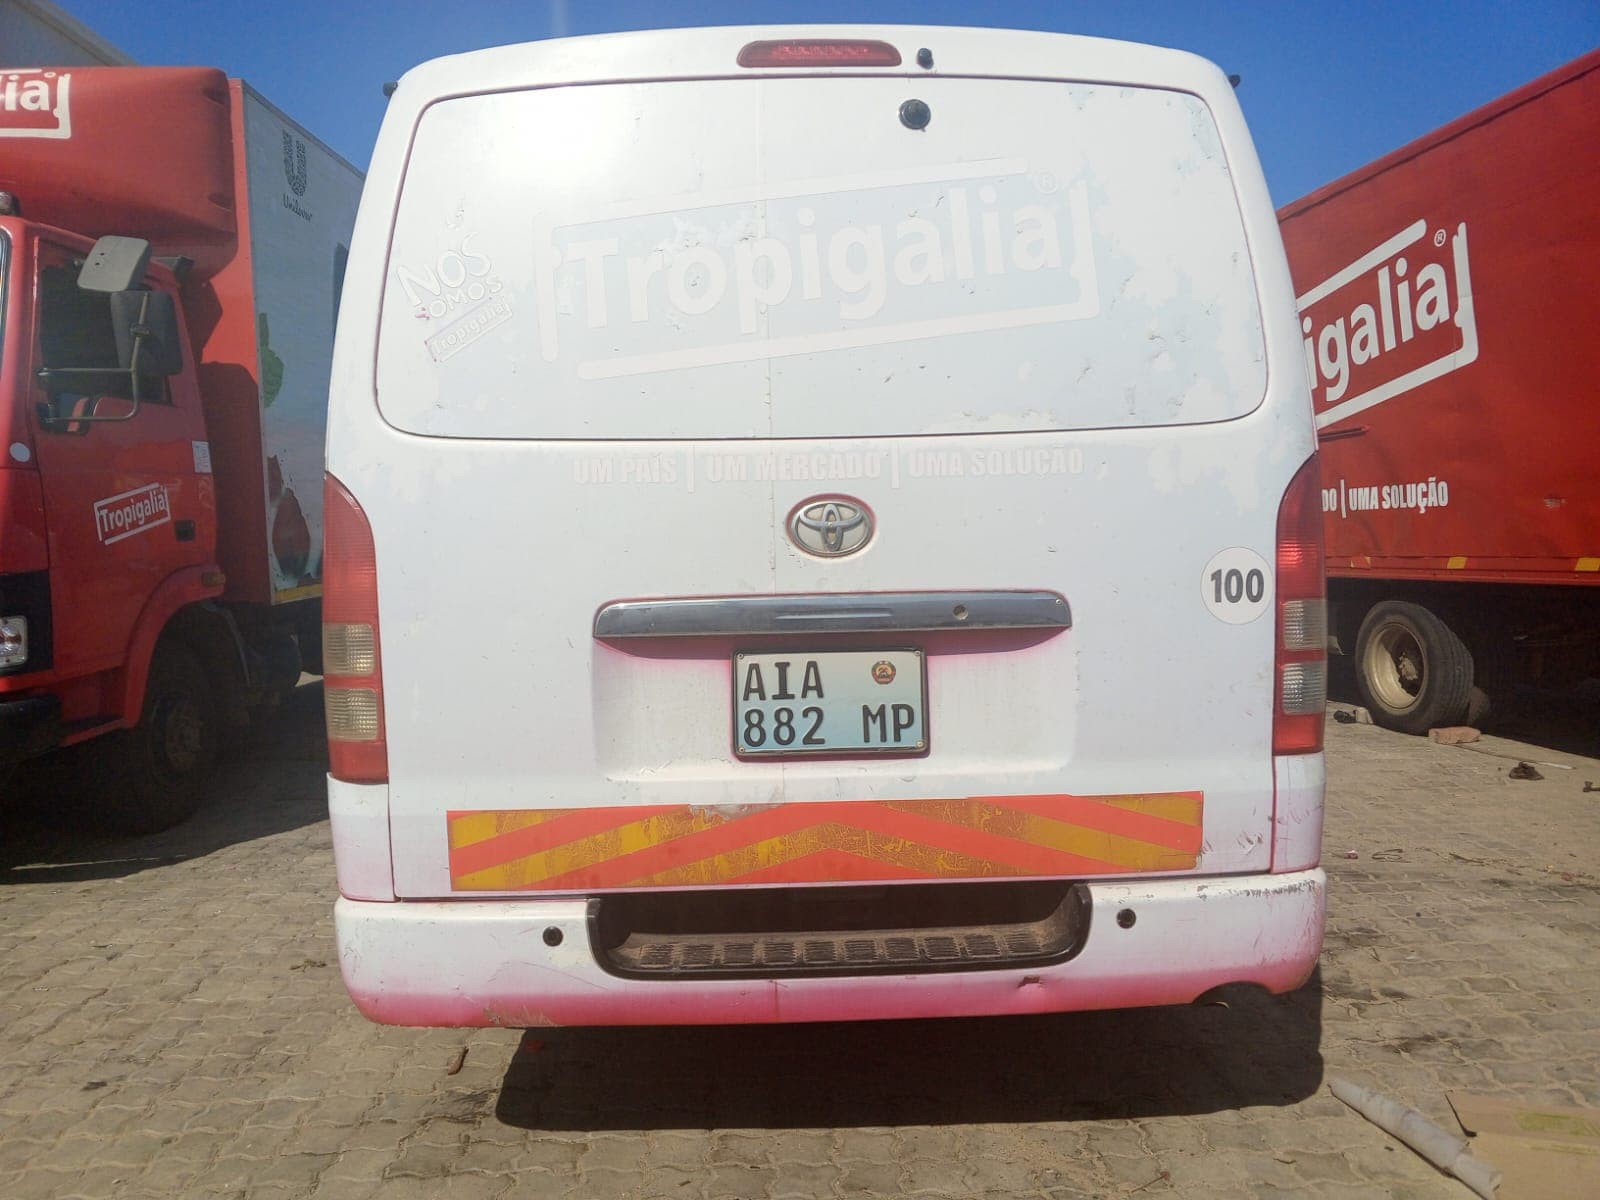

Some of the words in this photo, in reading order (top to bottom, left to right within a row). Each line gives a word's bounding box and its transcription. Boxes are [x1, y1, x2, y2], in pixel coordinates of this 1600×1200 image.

[565, 186, 1063, 334] Tropigalia
[415, 274, 503, 319] OMOS
[1302, 257, 1450, 402] igalia
[573, 456, 612, 484] UM
[707, 454, 748, 482] UM
[755, 452, 881, 482] MERCADO
[908, 451, 964, 478] UMA
[971, 443, 1083, 479] SOLUÇÃO
[99, 489, 165, 532] Tropigalia
[1349, 486, 1379, 511] UMA
[1382, 477, 1449, 514] SOLUÇÃO
[1210, 568, 1265, 603] 100
[743, 660, 824, 701] AIA
[744, 706, 825, 747] 882
[862, 703, 915, 743] MP
